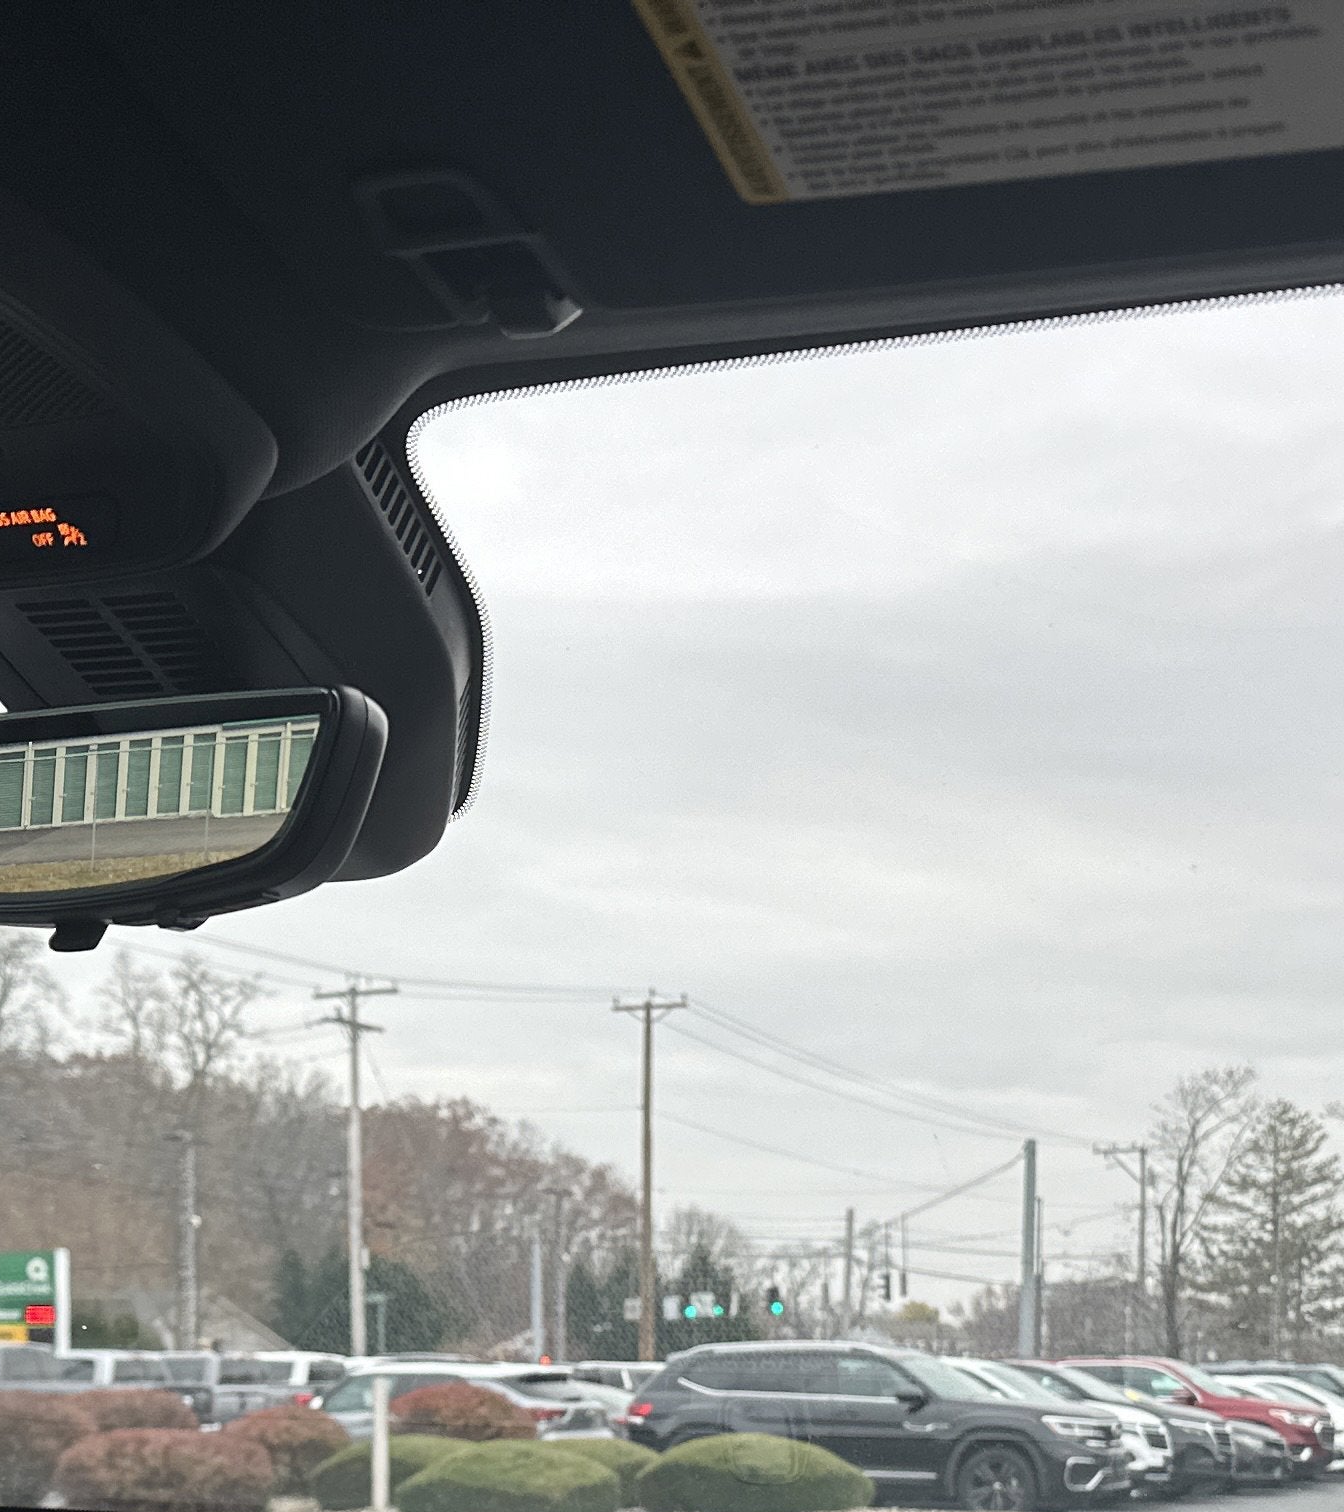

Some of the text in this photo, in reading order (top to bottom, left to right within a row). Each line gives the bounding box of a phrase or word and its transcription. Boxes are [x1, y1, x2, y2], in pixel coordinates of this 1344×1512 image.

[10, 509, 31, 525] AIR
[30, 507, 57, 523] BAG
[32, 532, 54, 548] OFF
